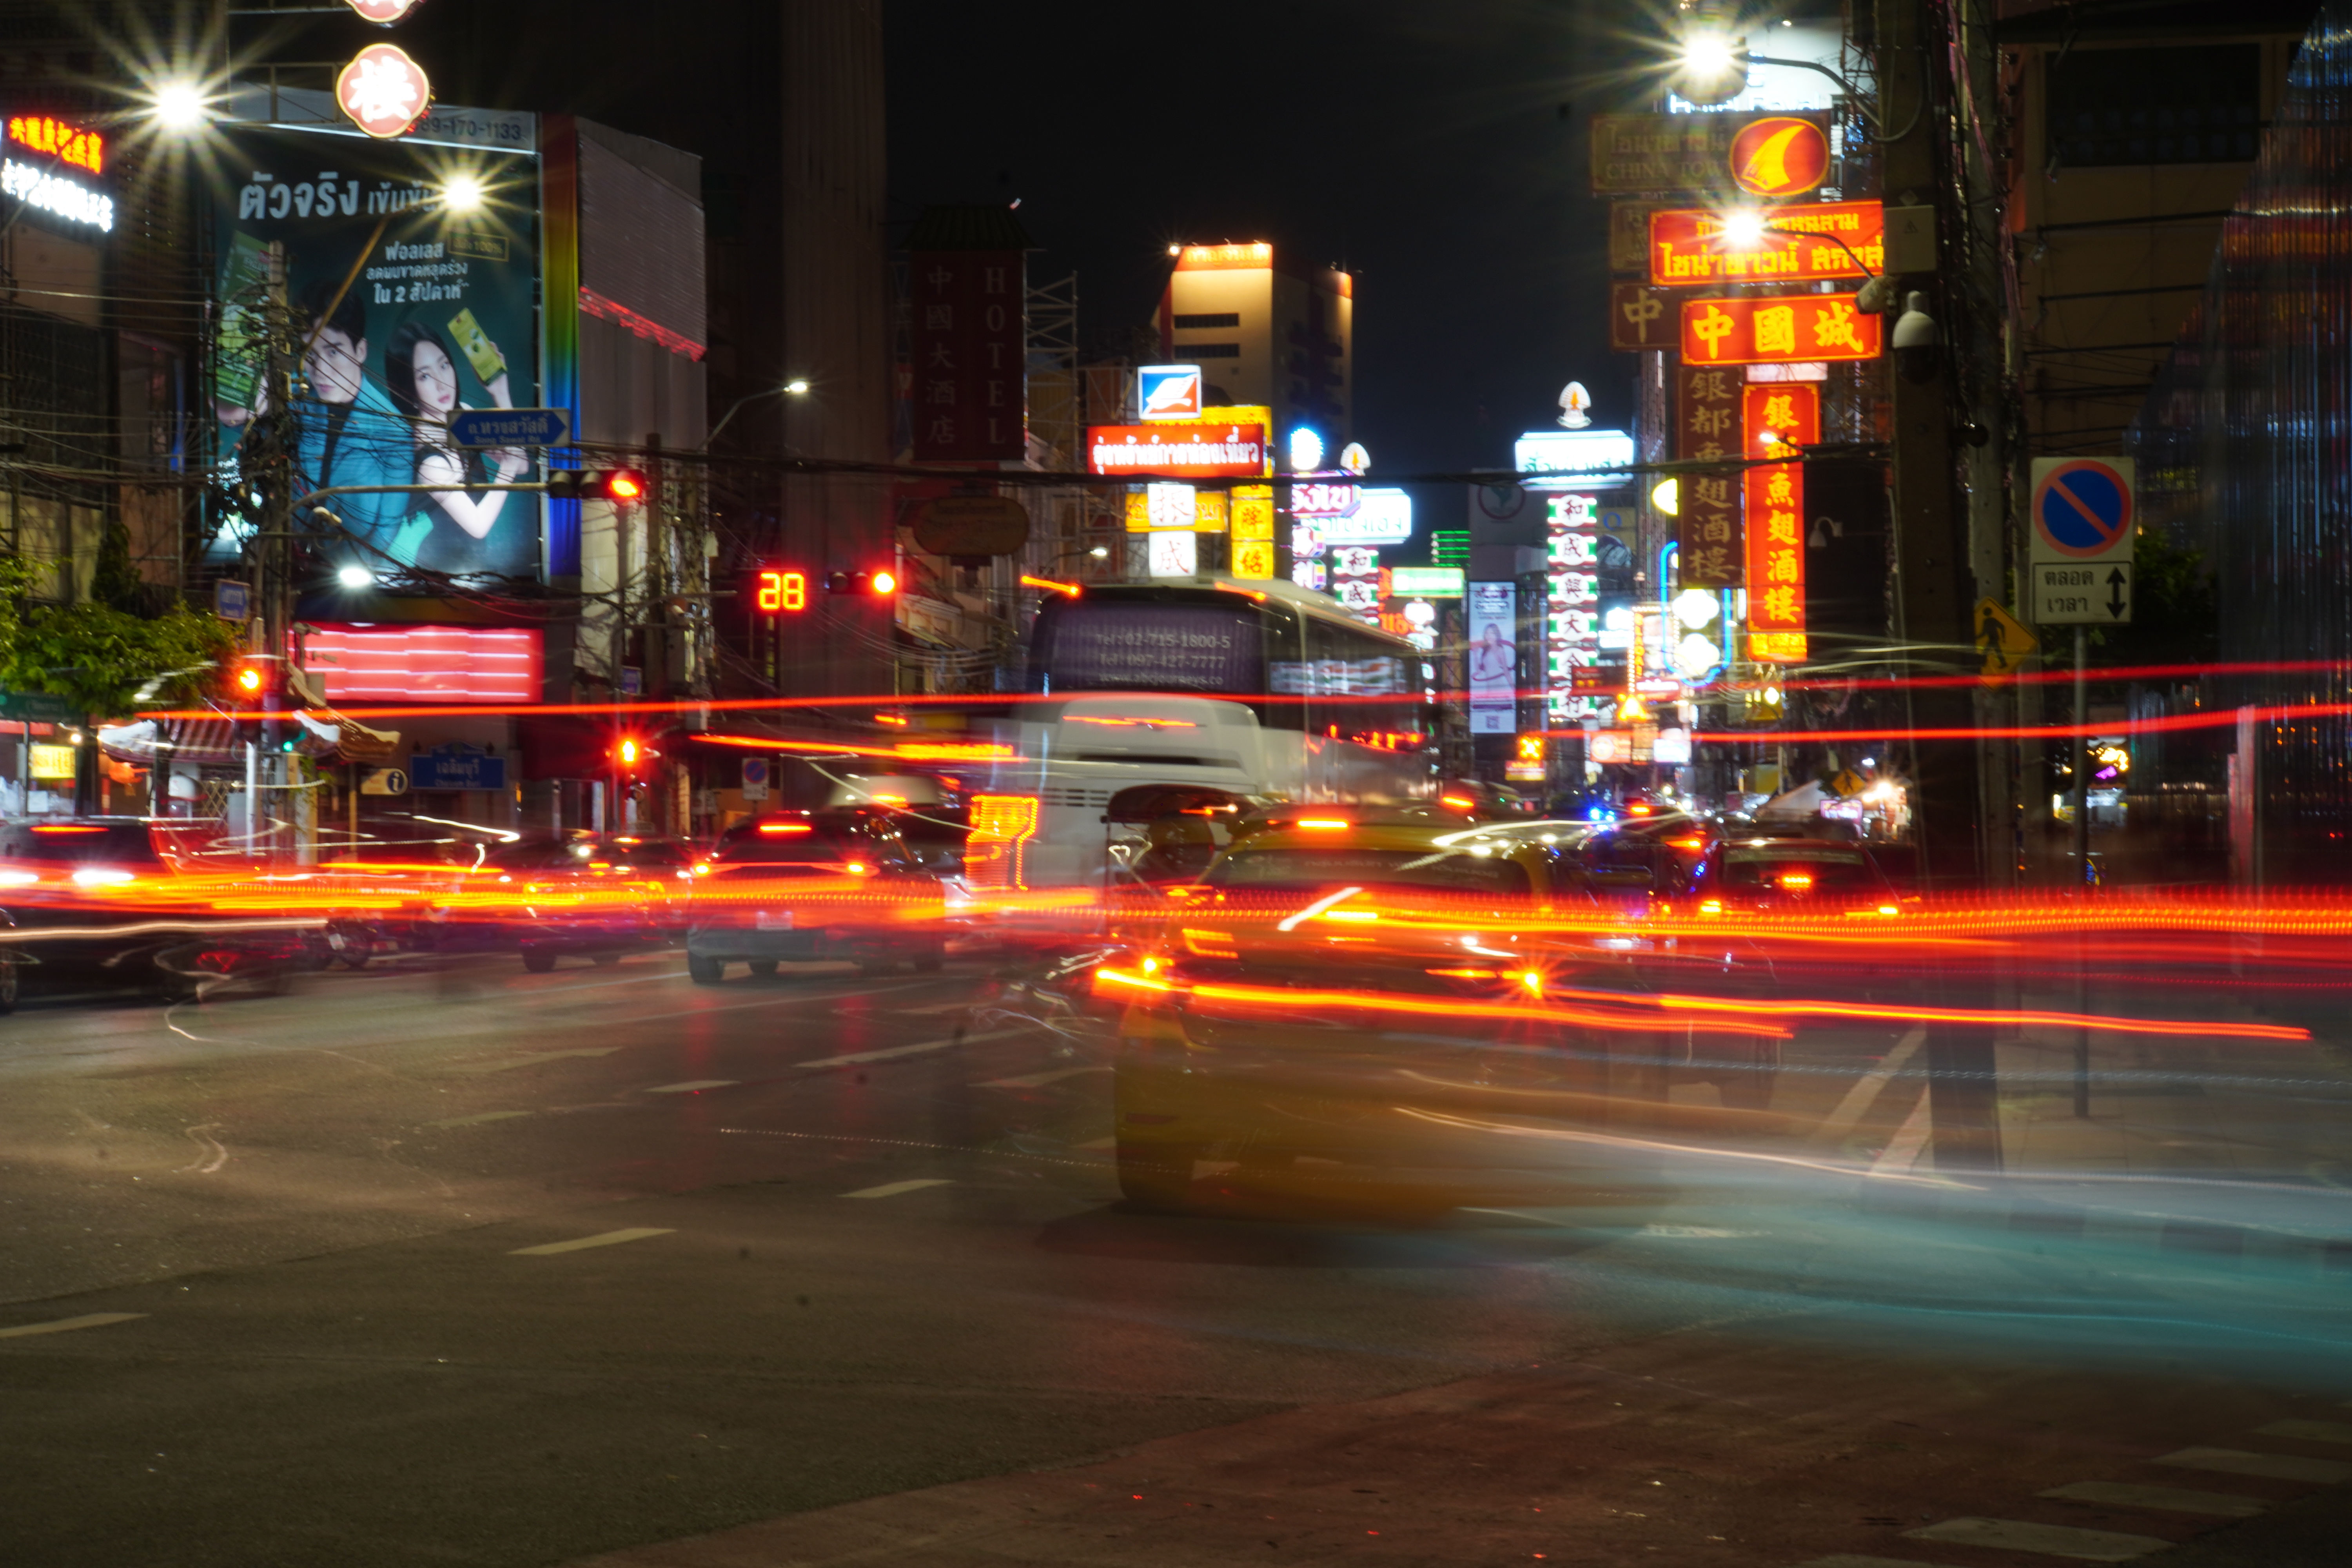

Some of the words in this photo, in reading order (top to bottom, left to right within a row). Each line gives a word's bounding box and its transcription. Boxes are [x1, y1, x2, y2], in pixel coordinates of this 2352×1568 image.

[420, 116, 522, 140] 89-170-1133
[239, 171, 360, 220] ตัวจริง
[1811, 234, 1883, 271] สกาล่
[373, 282, 391, 304] ใน
[394, 285, 406, 303] 2
[1691, 301, 1864, 360] 中國城
[926, 265, 957, 444] 中國大酒店
[984, 267, 1007, 444] HOTEL
[1347, 551, 1368, 603] 和成
[2044, 570, 2094, 587] ตลอด
[2047, 597, 2089, 613] เวลา
